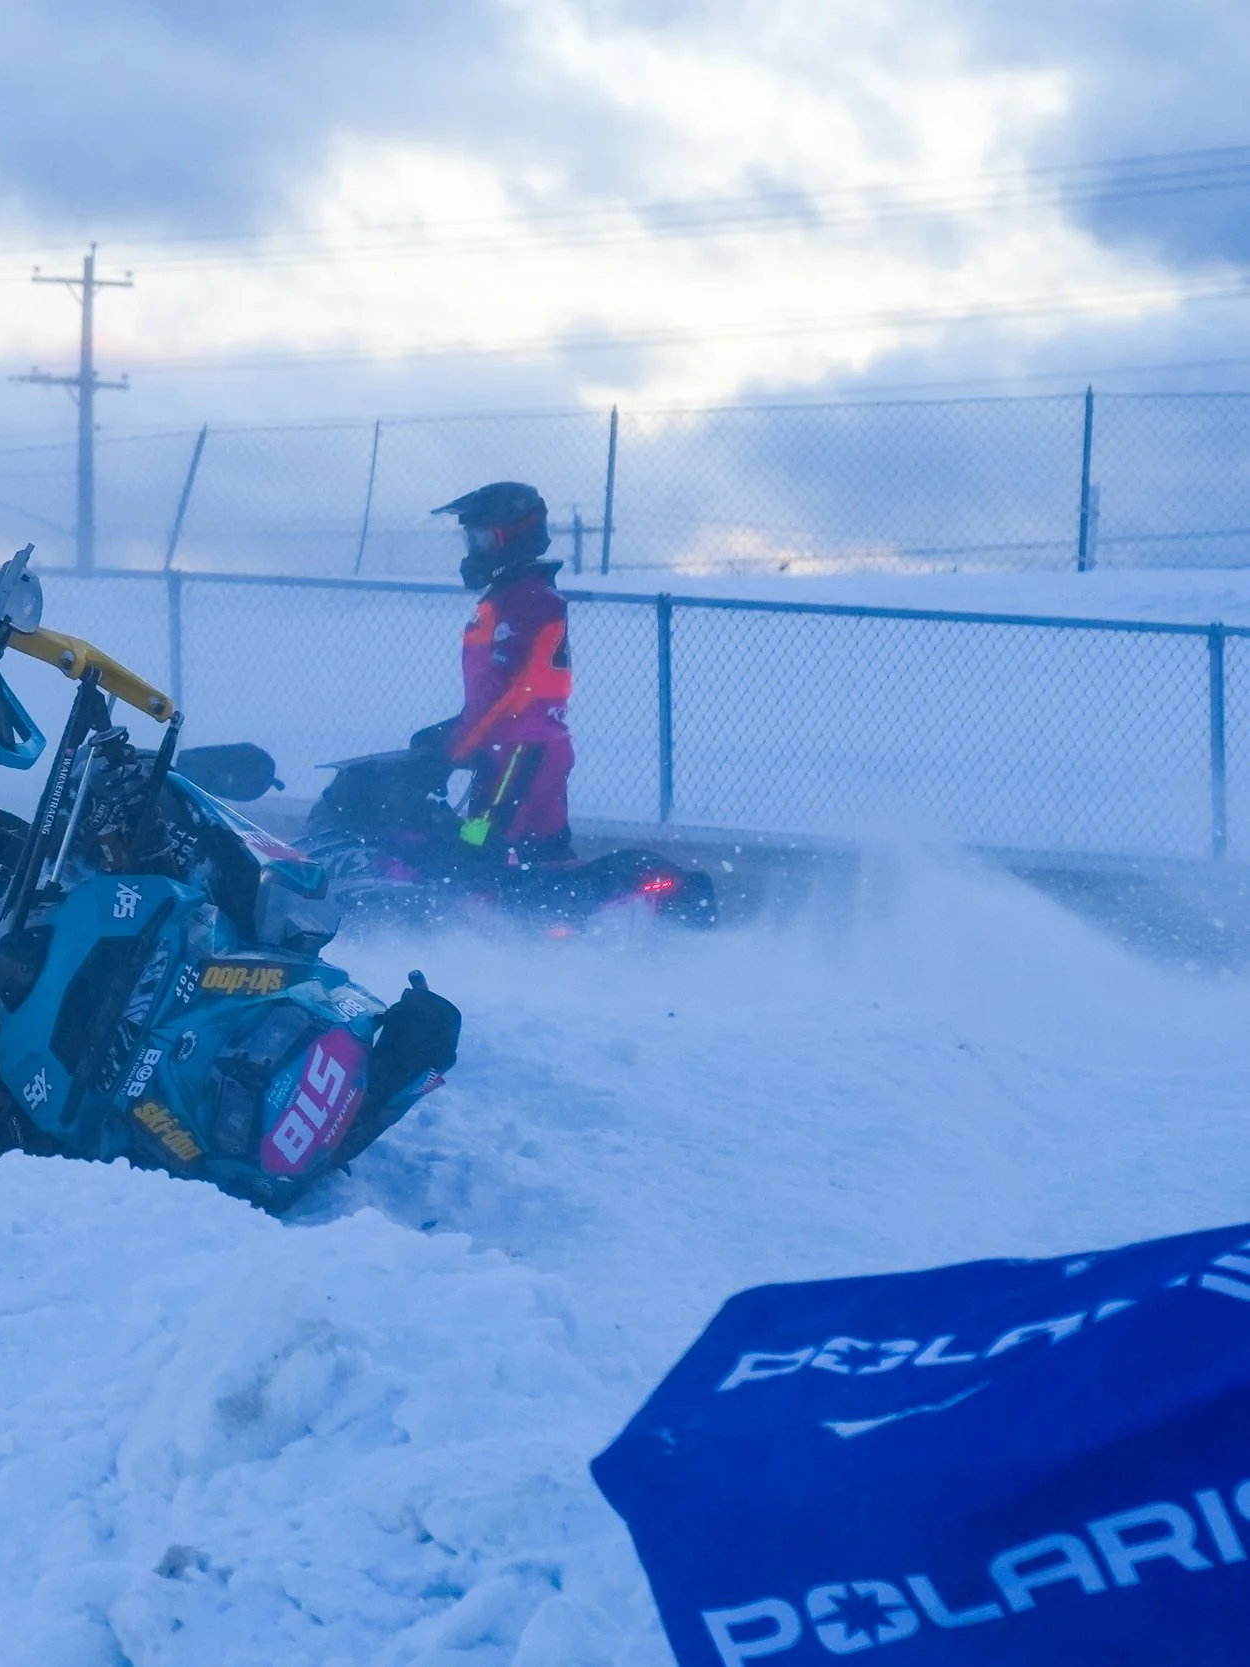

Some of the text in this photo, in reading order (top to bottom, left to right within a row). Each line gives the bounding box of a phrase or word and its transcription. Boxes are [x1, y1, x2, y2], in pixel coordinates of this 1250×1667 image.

[41, 757, 72, 836] WARNERTRACING
[175, 964, 193, 997] TOP
[182, 971, 200, 1004] TOP
[201, 966, 286, 996] ski-doo
[127, 1048, 163, 1097] BOB
[272, 1043, 346, 1165] 518
[701, 1478, 1250, 1667] POLARI
